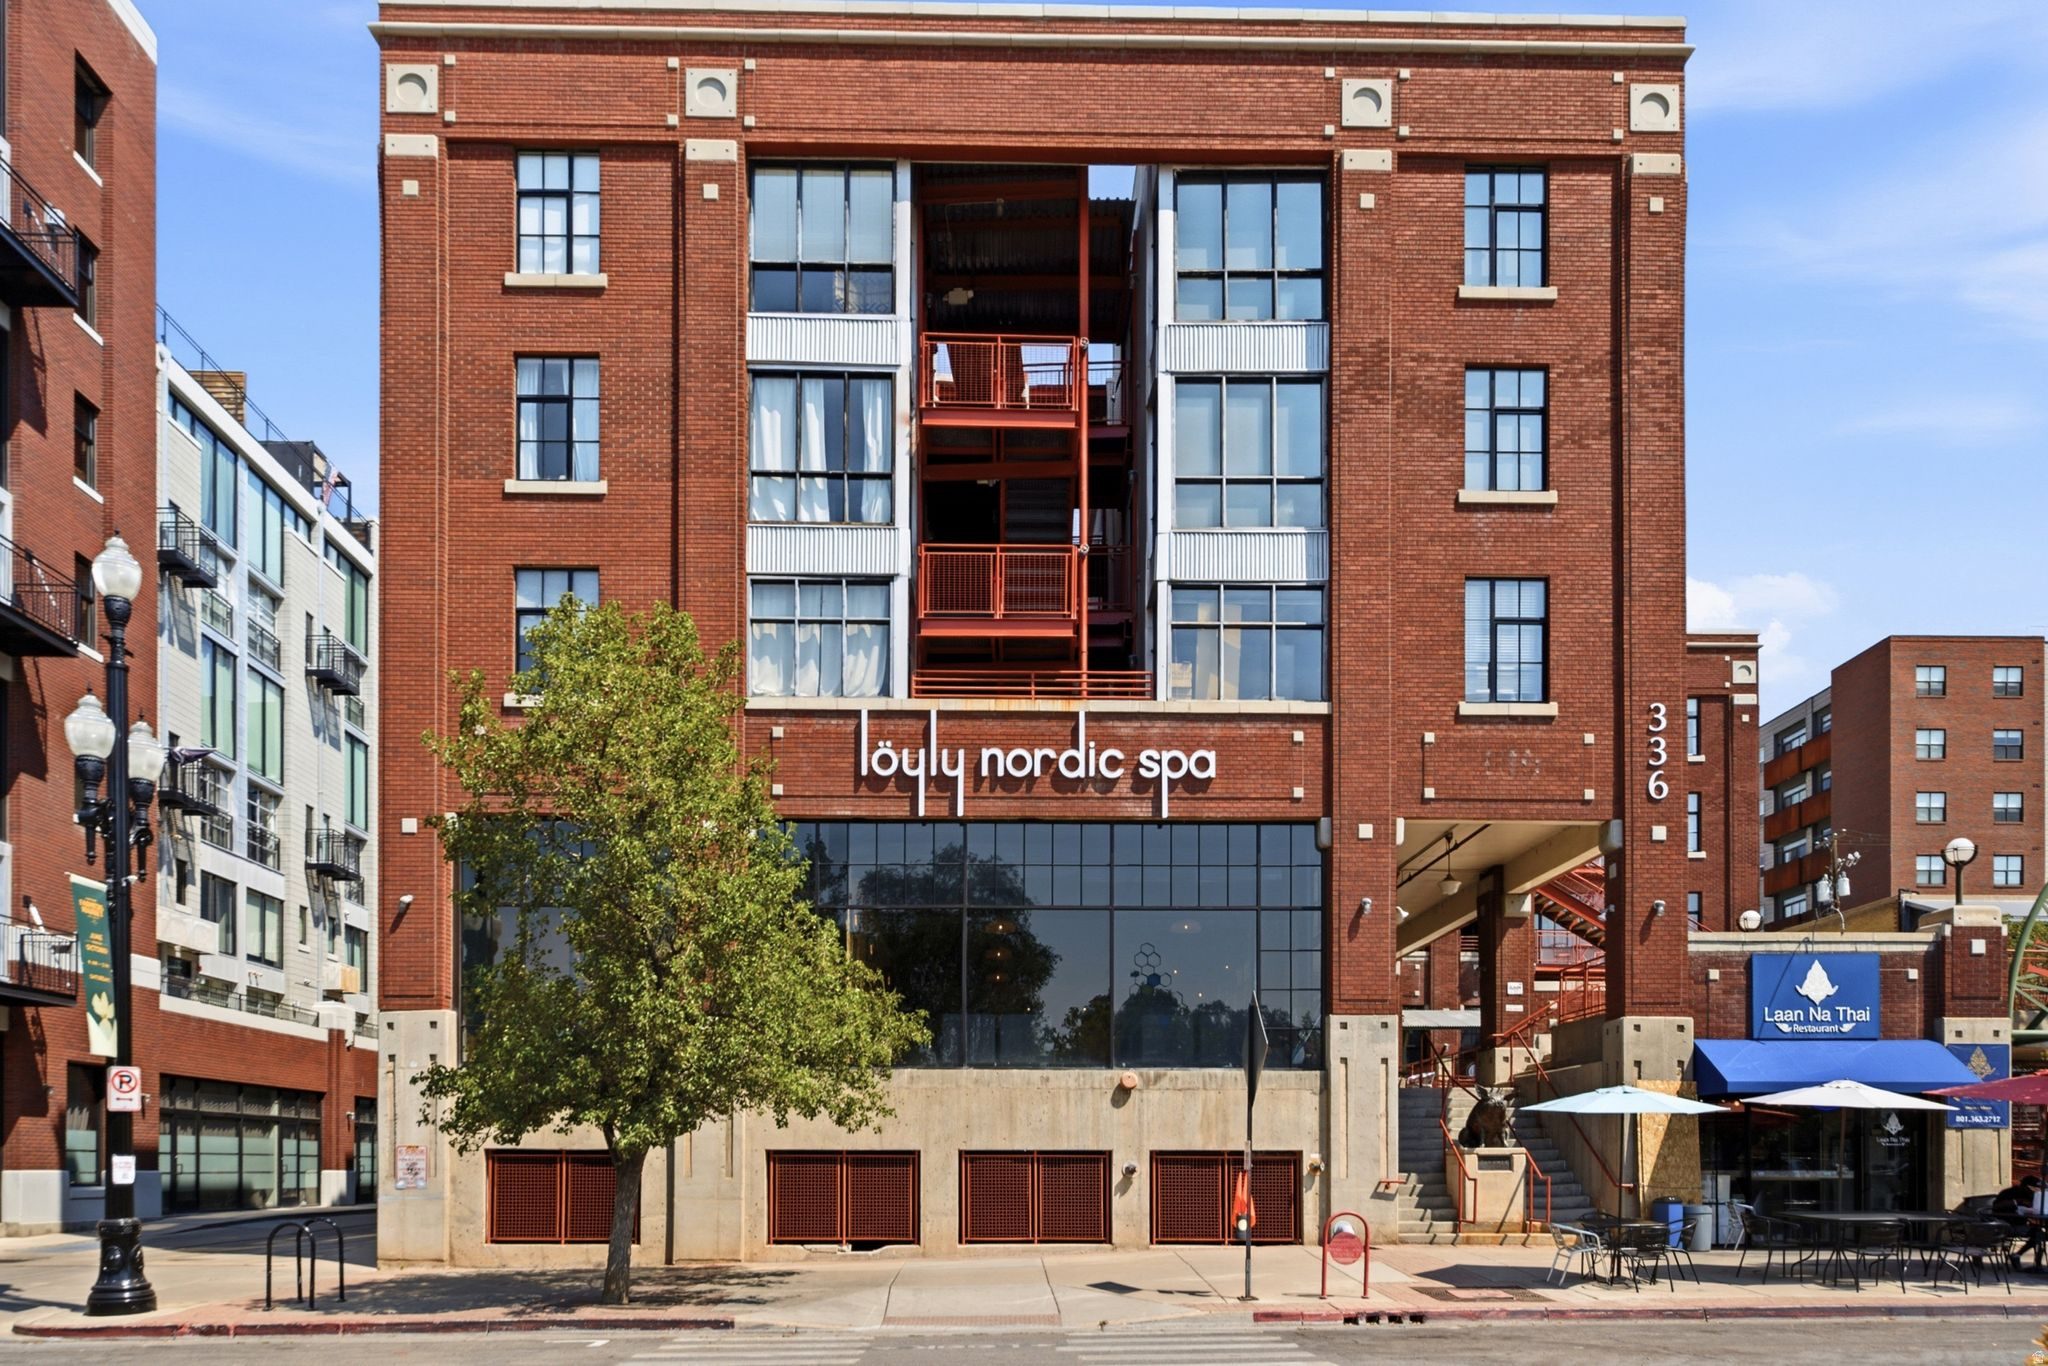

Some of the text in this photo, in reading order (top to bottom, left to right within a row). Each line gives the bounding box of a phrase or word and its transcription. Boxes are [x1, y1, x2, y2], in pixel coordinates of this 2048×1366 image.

[860, 709, 1216, 819] löyly nordic spa
[1764, 1006, 1870, 1022] Laan Na Thai
[1793, 1024, 1839, 1033] Restaurant
